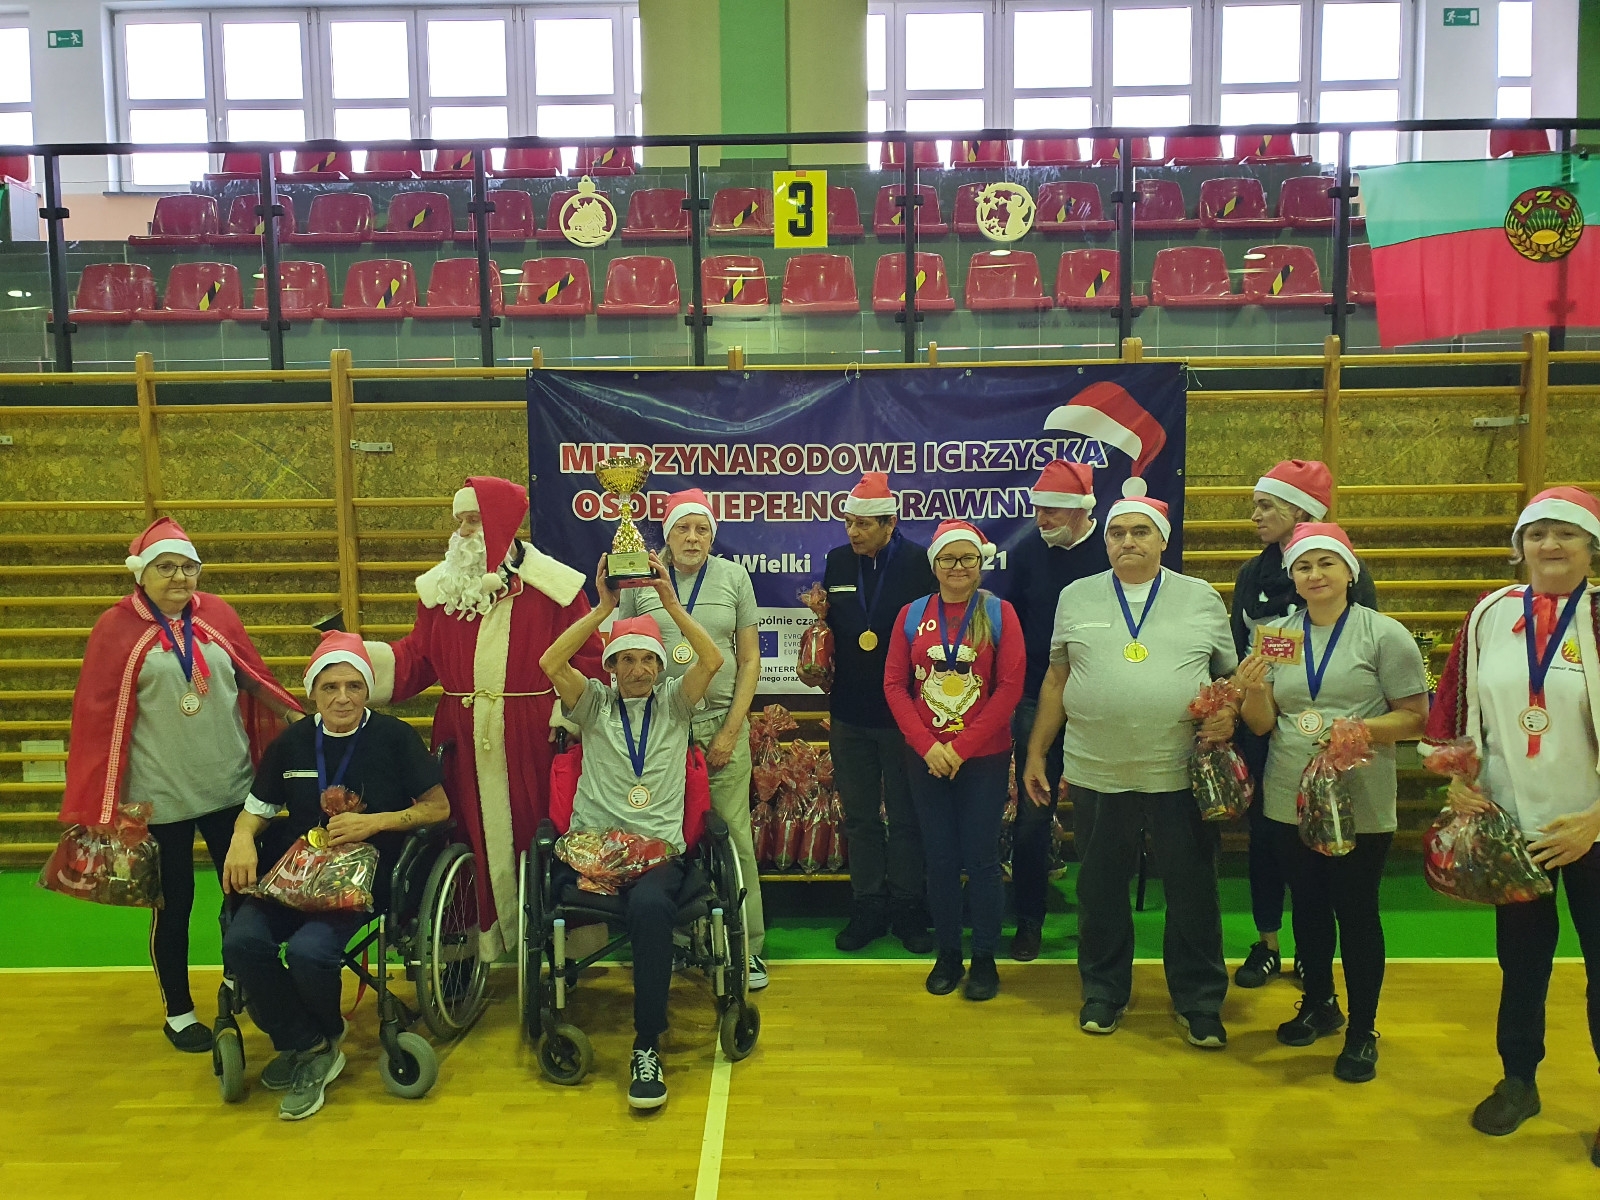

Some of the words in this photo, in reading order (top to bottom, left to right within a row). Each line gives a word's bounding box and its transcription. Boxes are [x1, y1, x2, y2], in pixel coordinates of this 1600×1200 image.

[788, 181, 813, 237] 3
[1514, 190, 1573, 215] LZS
[924, 438, 1108, 472] IGRZYSKA
[733, 553, 811, 573] Wielki
